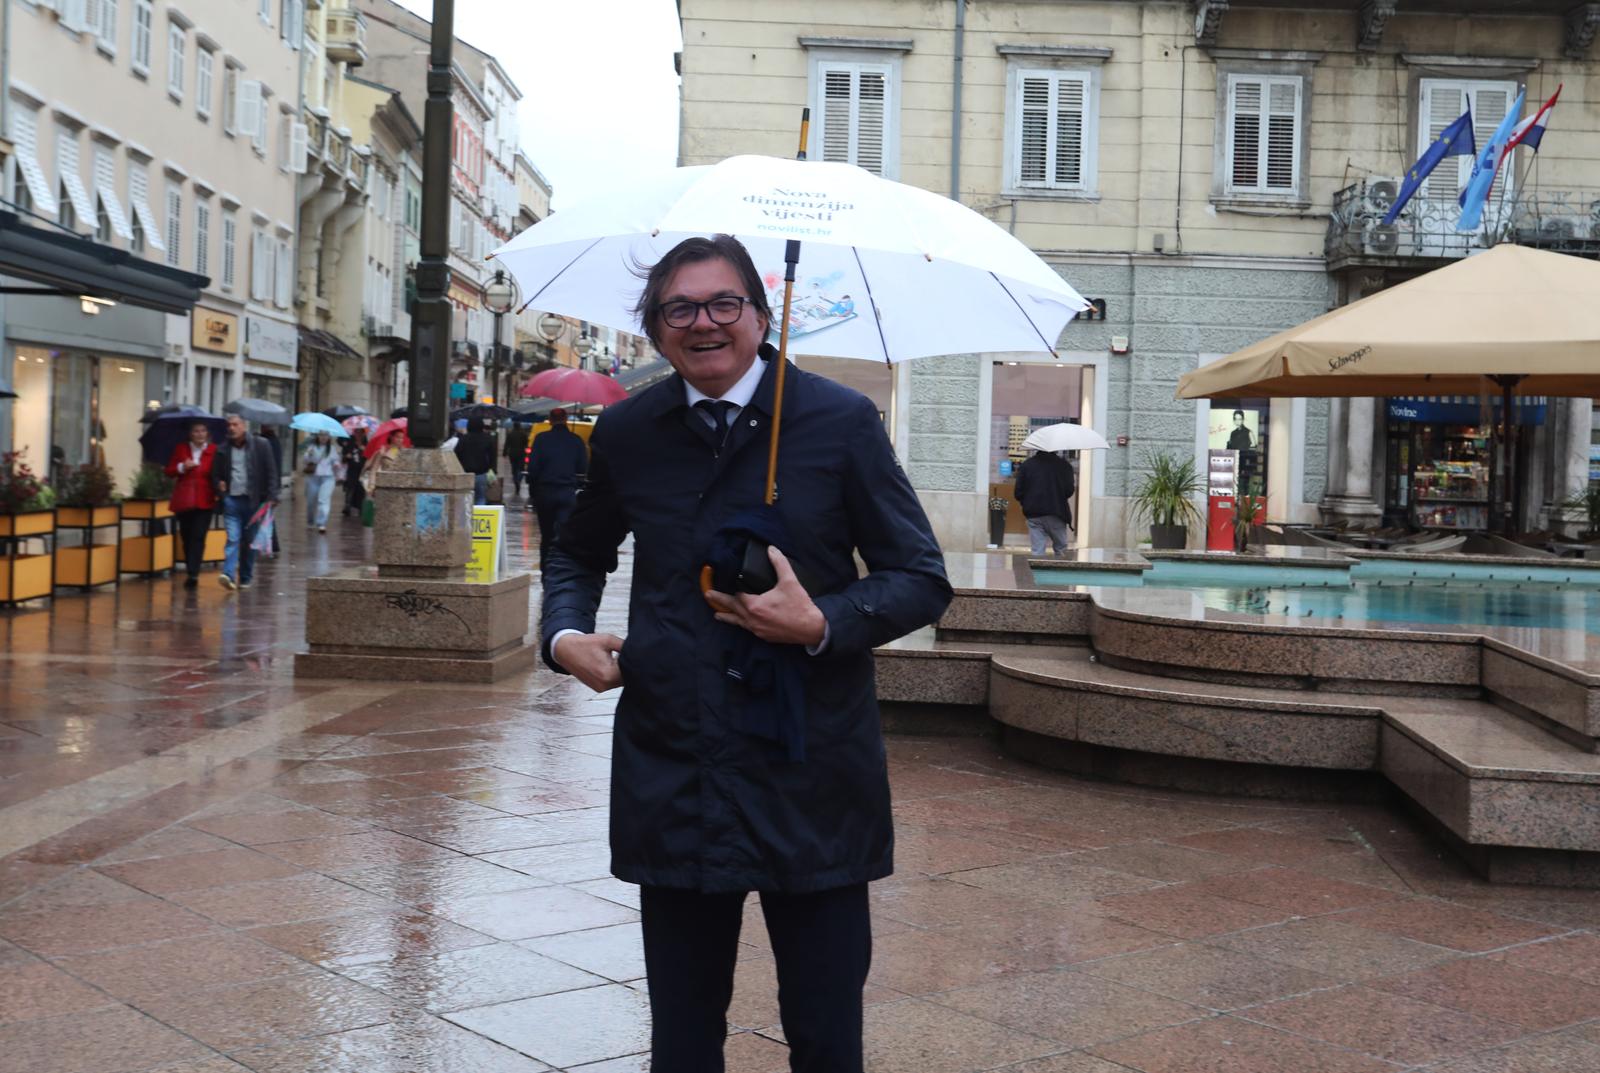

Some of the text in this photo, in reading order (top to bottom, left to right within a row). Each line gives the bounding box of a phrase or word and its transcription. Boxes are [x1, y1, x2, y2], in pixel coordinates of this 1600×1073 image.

[774, 187, 827, 199] Nova
[742, 195, 855, 212] dimenzija
[762, 209, 833, 221] vijesti
[756, 223, 833, 236] novilist.hr
[1391, 405, 1417, 418] Novine
